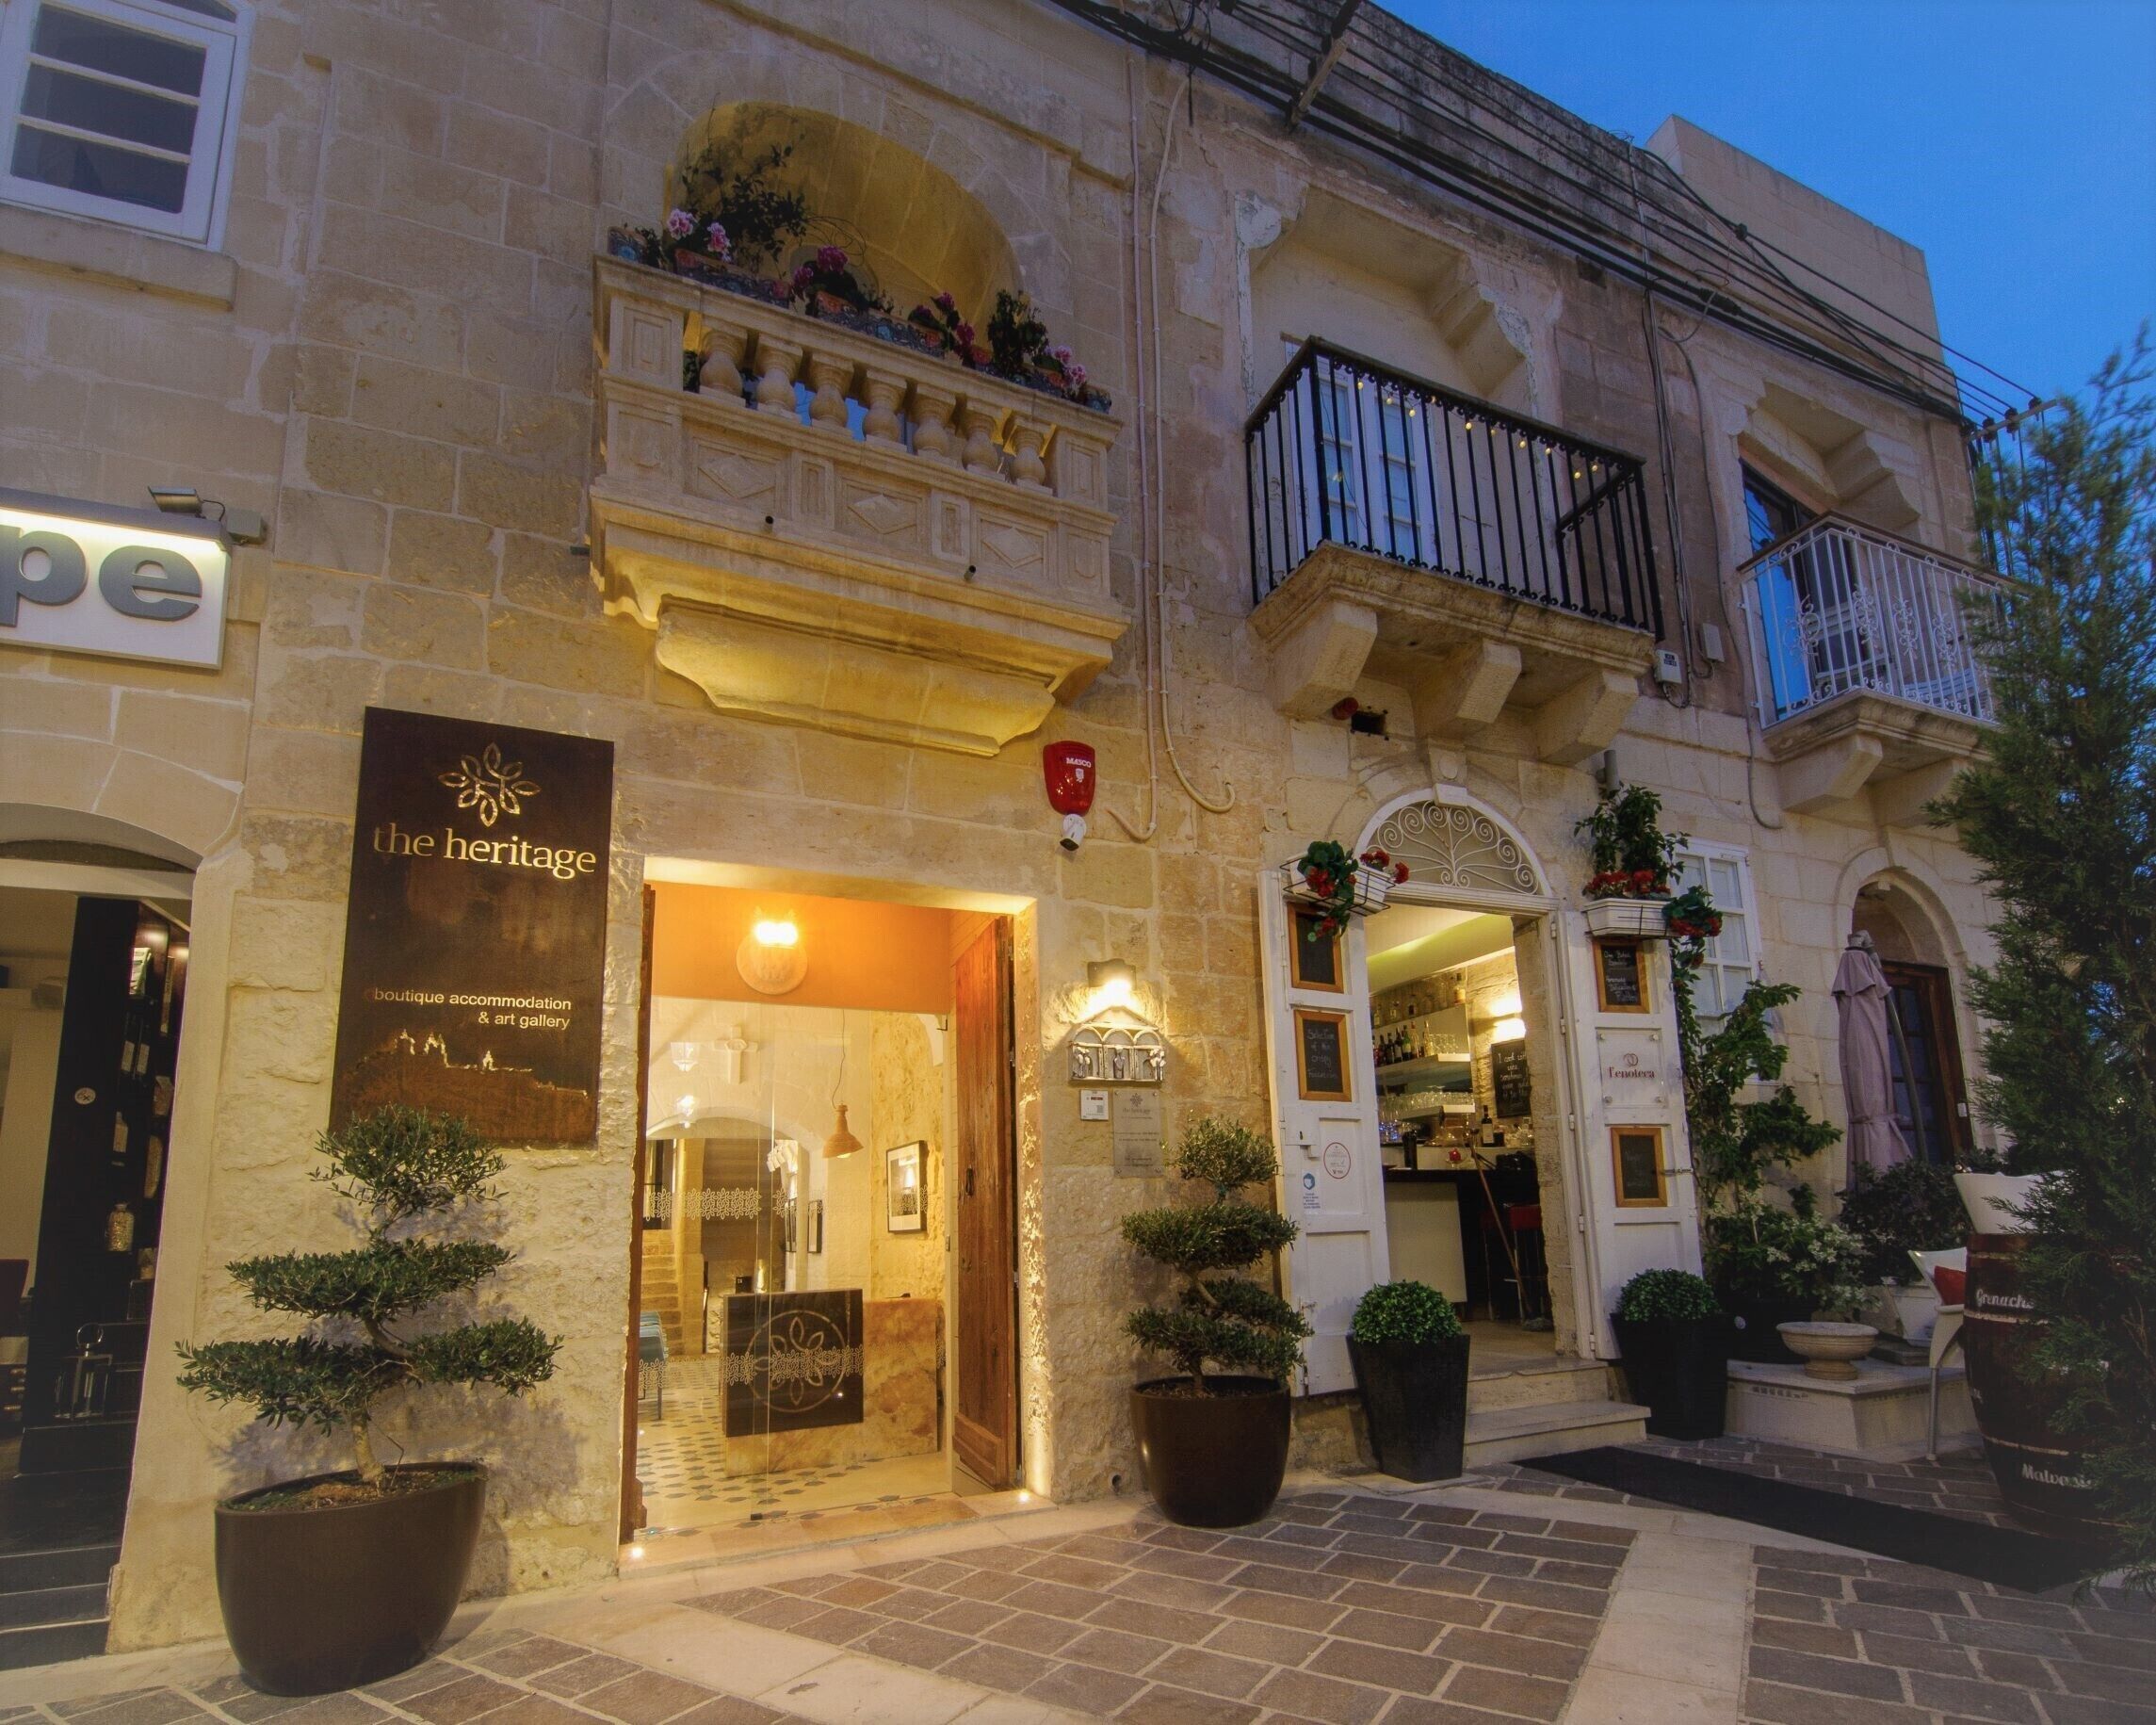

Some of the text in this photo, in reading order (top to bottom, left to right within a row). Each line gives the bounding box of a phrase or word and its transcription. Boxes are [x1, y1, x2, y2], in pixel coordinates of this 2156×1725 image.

[1065, 757, 1092, 769] MASCO
[373, 822, 597, 880] the heritage
[375, 988, 572, 1011] boutique accommodation
[478, 1010, 571, 1031] & art gallery
